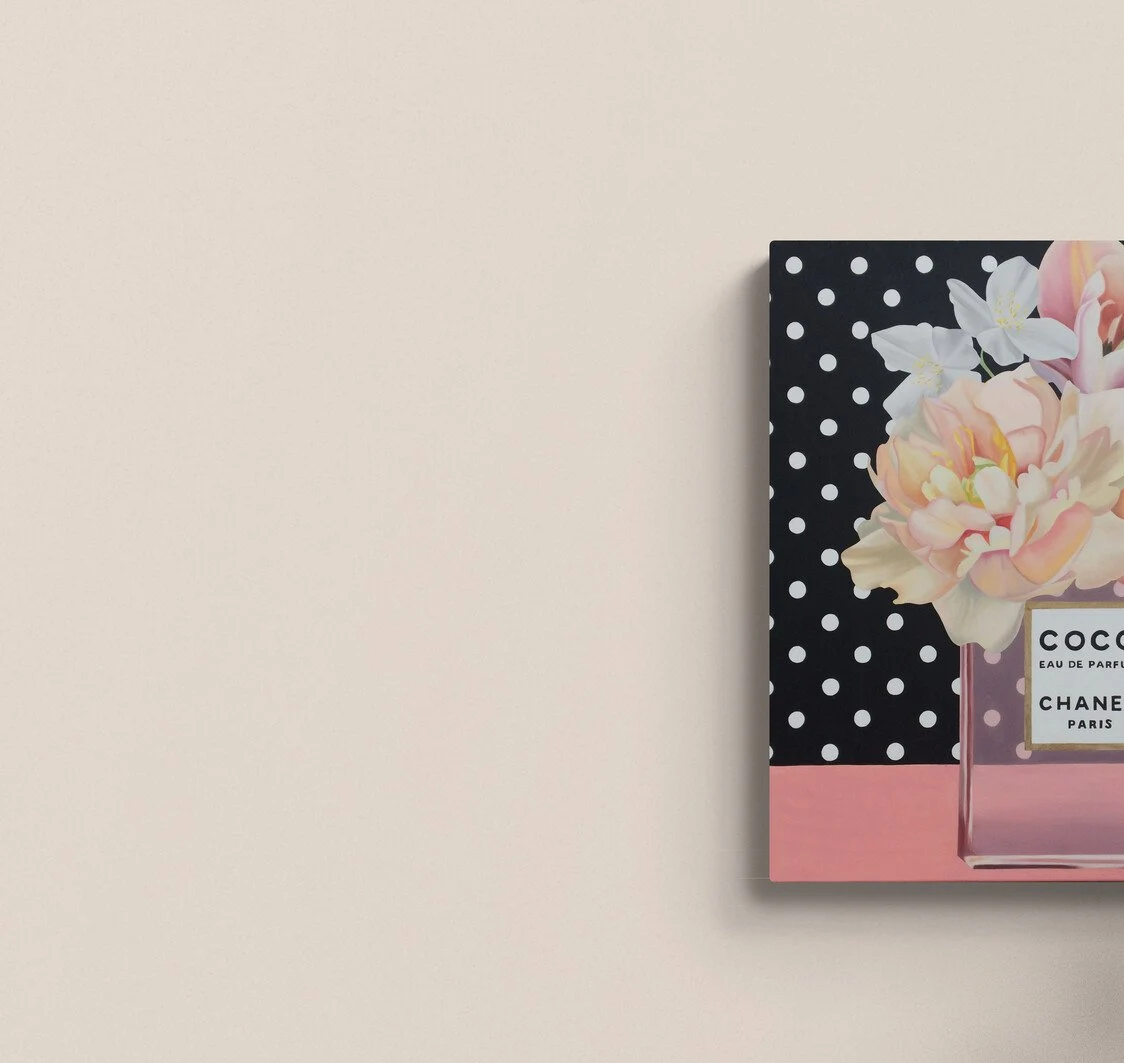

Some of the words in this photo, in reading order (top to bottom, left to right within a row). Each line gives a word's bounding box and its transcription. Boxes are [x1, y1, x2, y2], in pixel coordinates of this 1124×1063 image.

[1039, 660, 1064, 669] EAU
[1068, 660, 1084, 669] DE
[1067, 719, 1113, 729] PARIS
